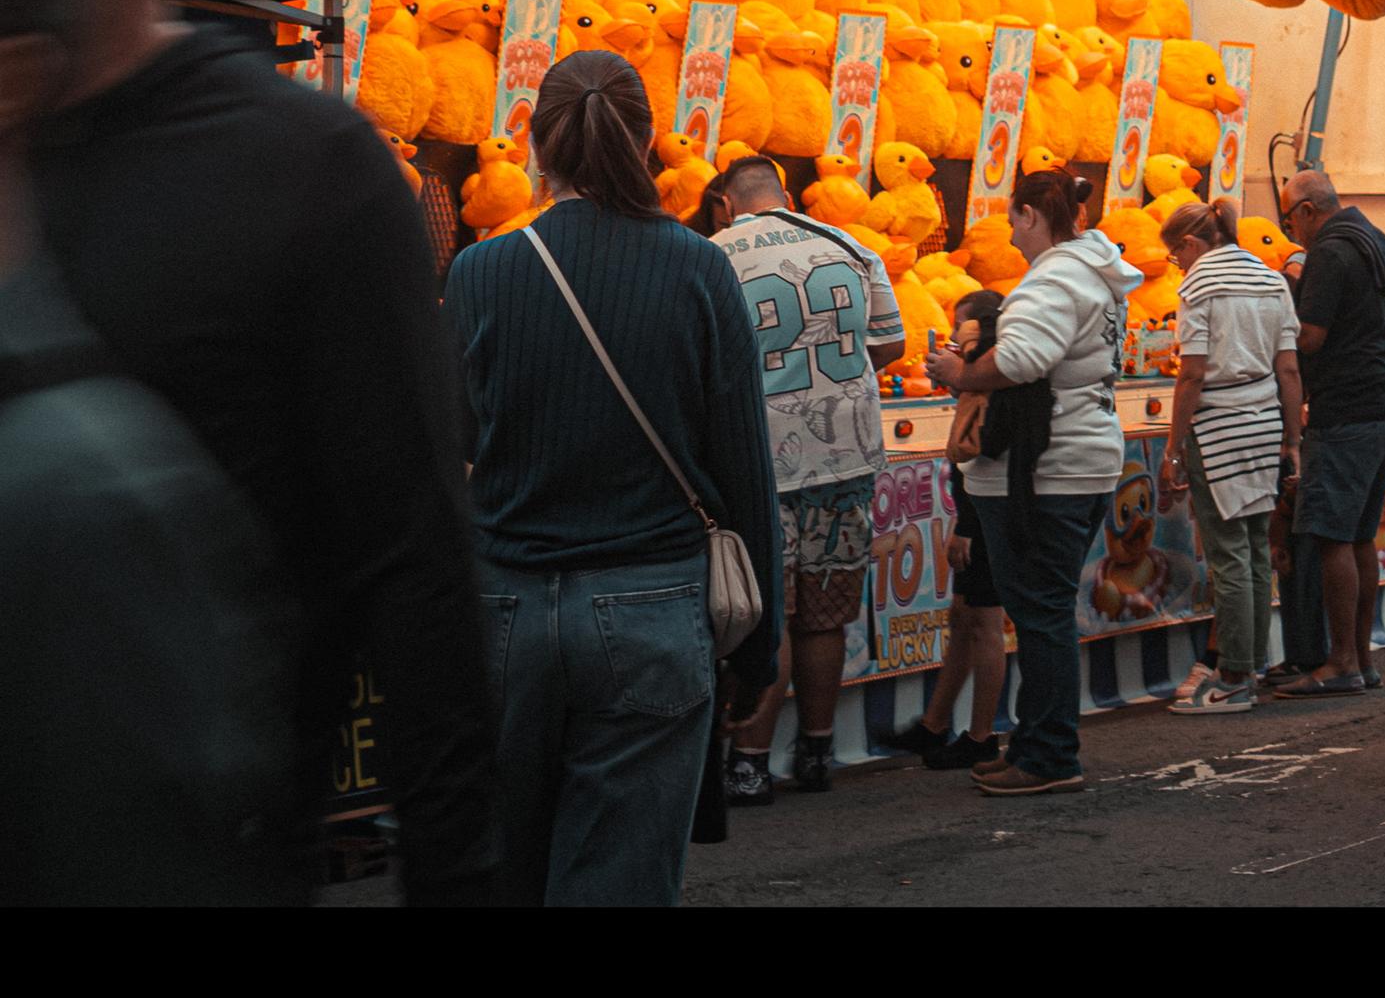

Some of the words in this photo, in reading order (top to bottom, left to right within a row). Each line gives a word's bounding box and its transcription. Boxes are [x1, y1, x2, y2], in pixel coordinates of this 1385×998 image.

[983, 120, 1010, 190] 3
[1119, 125, 1142, 191] 3
[1221, 129, 1239, 192] 3
[741, 261, 869, 398] 23
[870, 522, 923, 613] TO
[875, 632, 936, 672] LUCKY
[889, 615, 919, 636] EVERY
[918, 608, 950, 632] PLAYE
